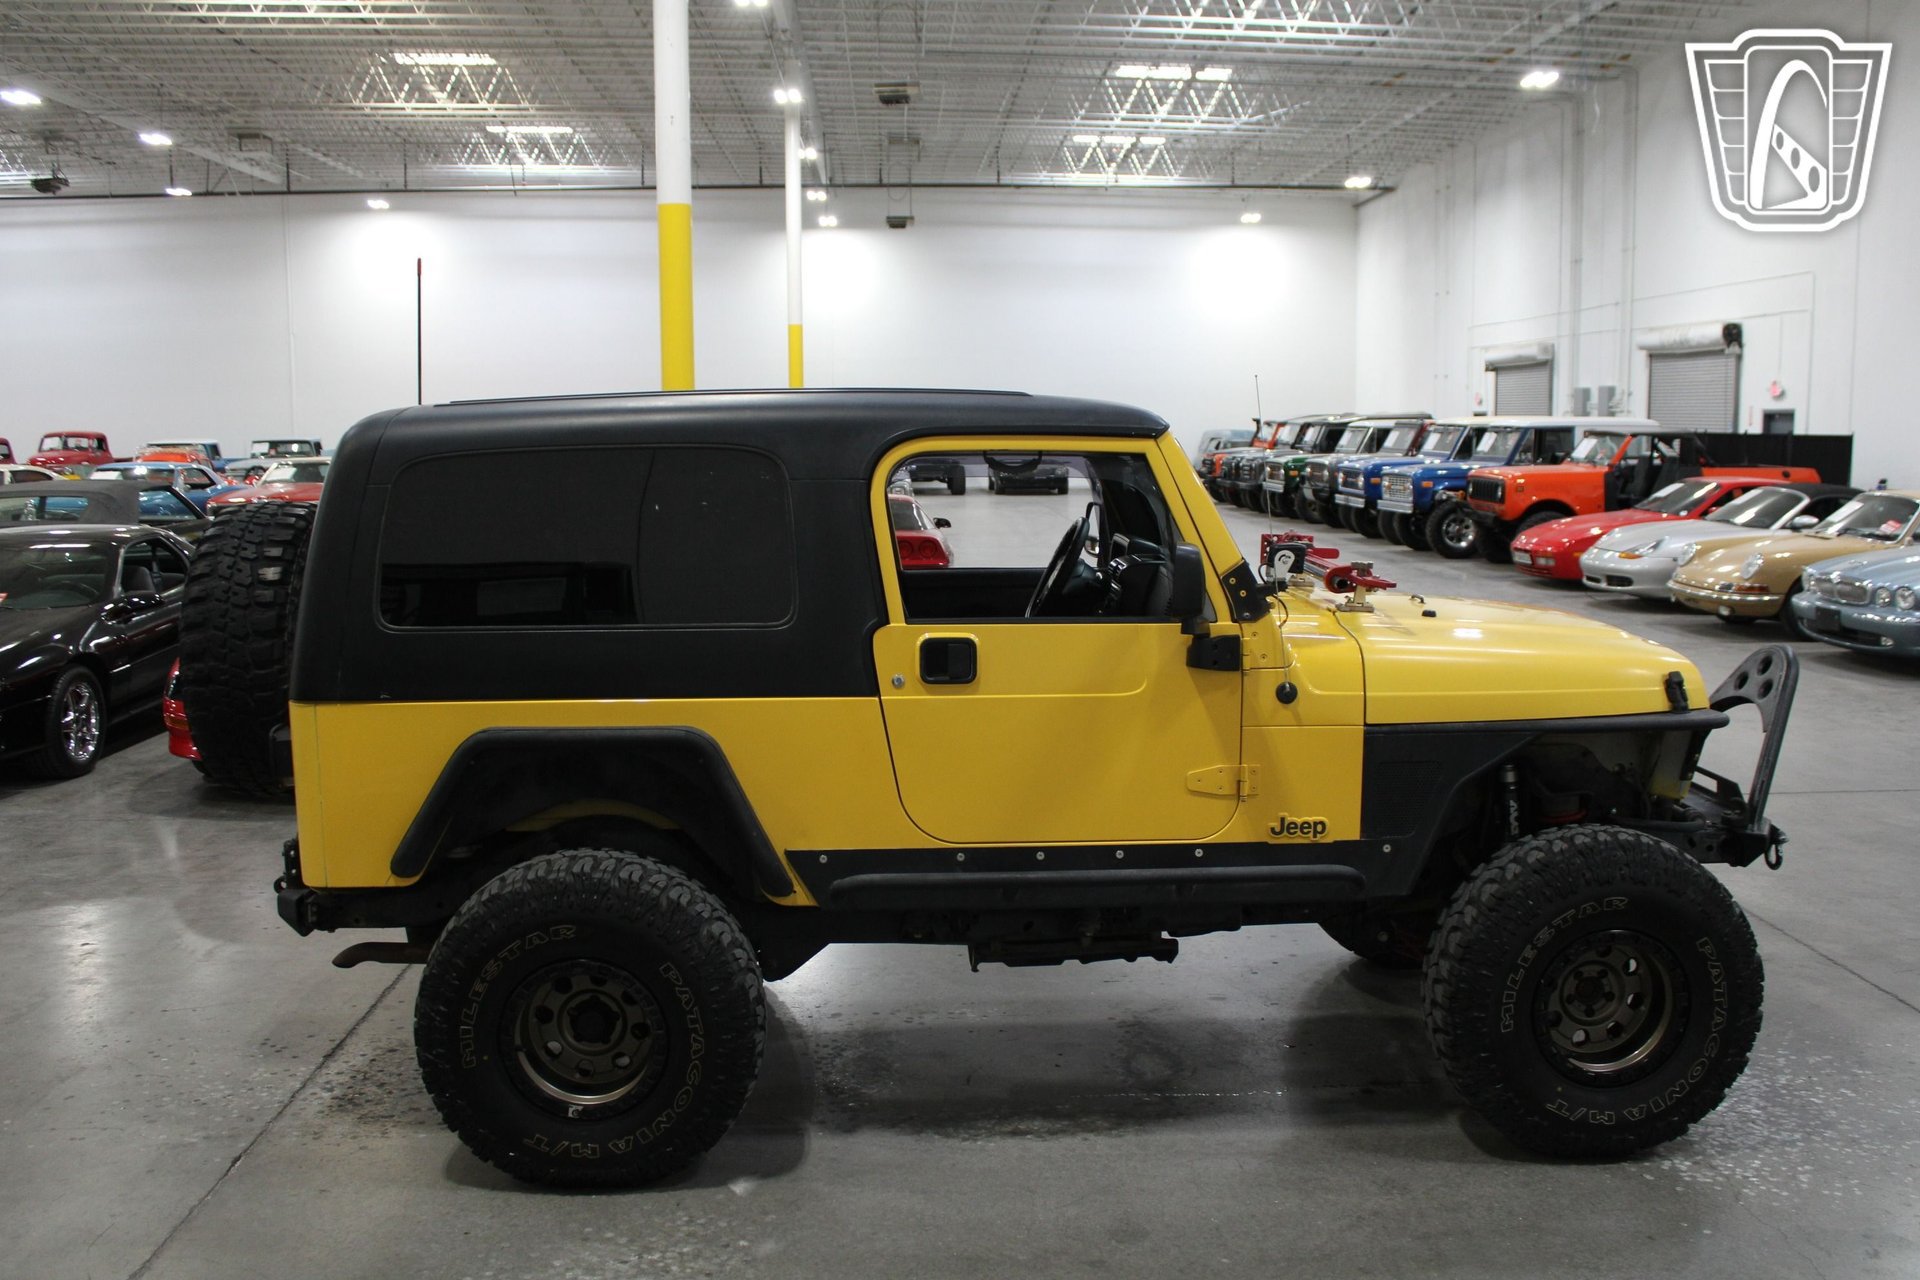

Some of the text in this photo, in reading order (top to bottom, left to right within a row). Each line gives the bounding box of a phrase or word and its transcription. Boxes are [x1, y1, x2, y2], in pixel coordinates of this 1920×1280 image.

[1269, 816, 1328, 839] Jeep
[459, 925, 577, 1068] MILESTAR
[1501, 896, 1631, 1032] MILESTAR
[1545, 937, 1728, 1125] PATAGONIA M/T
[522, 962, 704, 1159] PATAGONIA M/T
